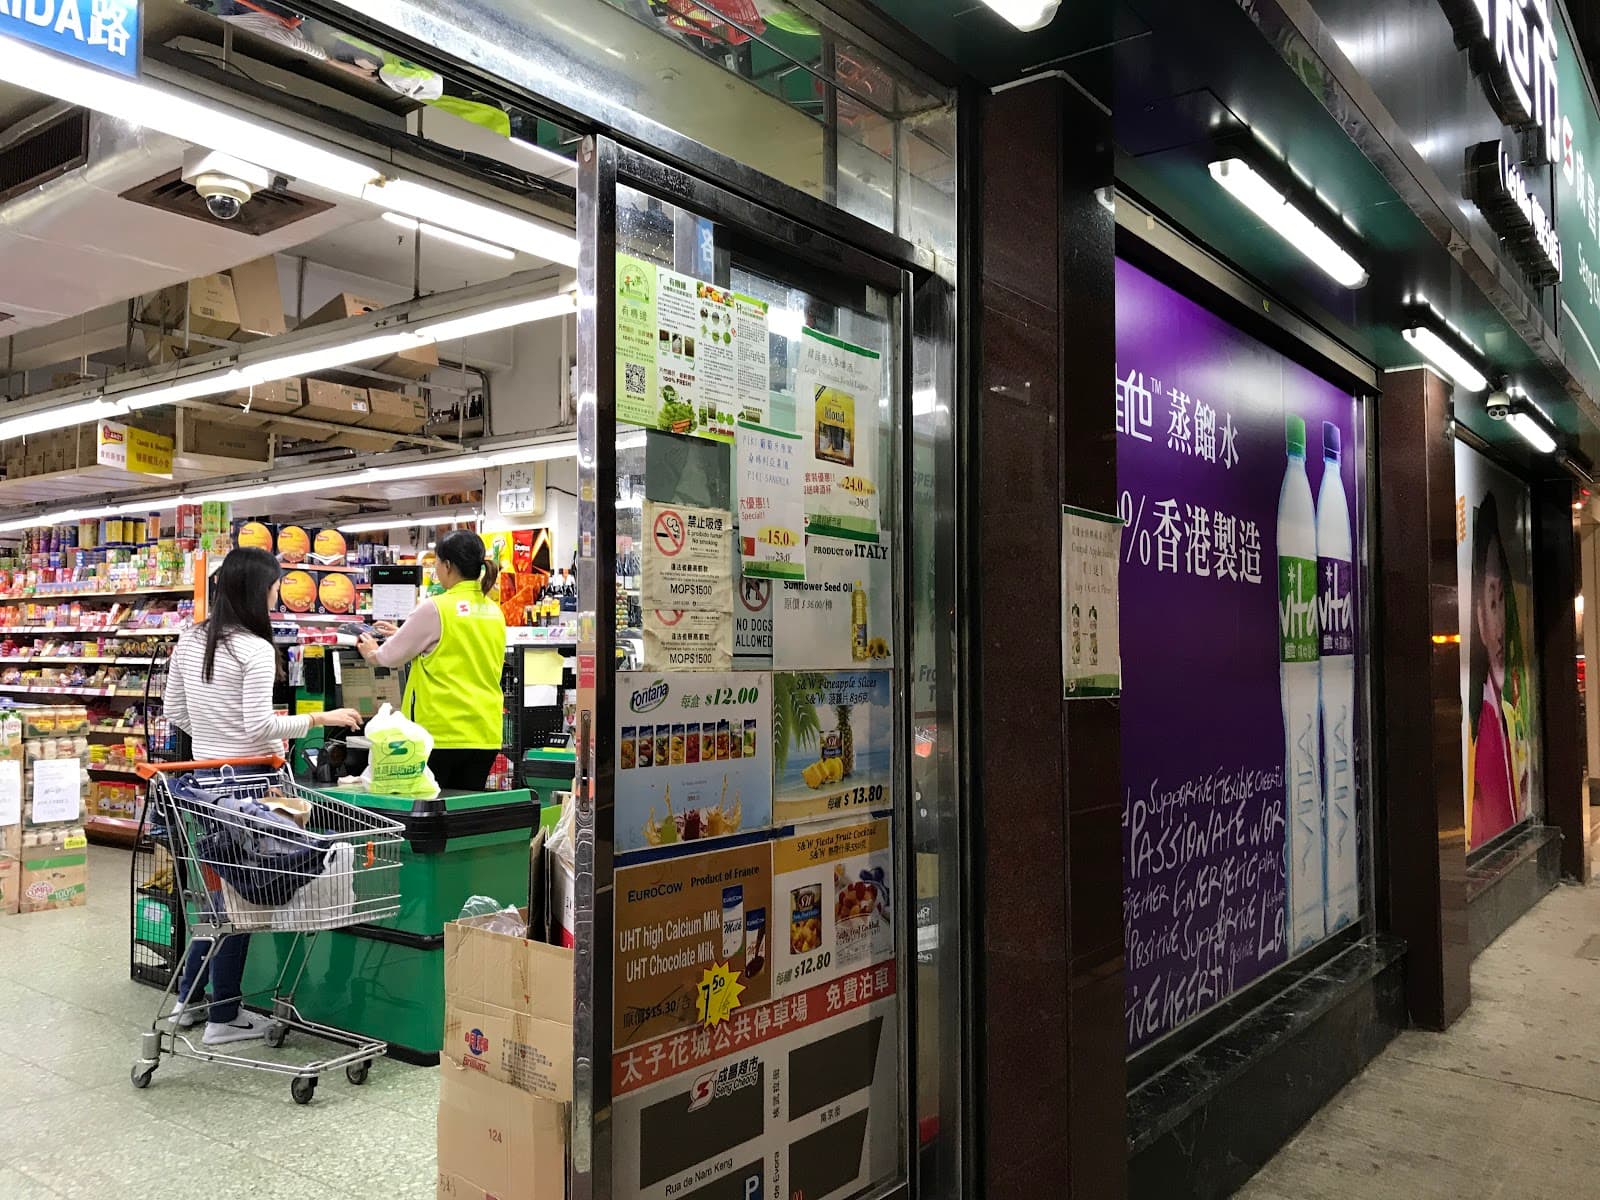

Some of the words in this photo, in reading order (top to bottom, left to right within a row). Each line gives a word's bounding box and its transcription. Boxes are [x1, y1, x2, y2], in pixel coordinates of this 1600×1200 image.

[1167, 387, 1240, 470] 蒸餾水
[687, 515, 723, 531] 禁止吸煙
[768, 530, 790, 545] 15.0
[1116, 489, 1263, 585] %香港製造
[814, 546, 844, 557] PRODUCT
[854, 543, 889, 560] ITALY
[784, 581, 822, 591] Sunflower
[824, 582, 841, 592] Seed
[843, 583, 853, 593] Oil
[736, 618, 748, 632] NO
[751, 618, 773, 632] DOGS
[736, 635, 773, 648] ALLOWED
[631, 682, 669, 707] Fontana
[704, 687, 759, 706] $12.00
[852, 784, 883, 804] 13.80
[690, 872, 722, 887] Product
[724, 869, 733, 880] of
[734, 865, 759, 879] France
[620, 926, 641, 953] UHT
[643, 921, 664, 947] high
[665, 915, 702, 941] Calcium
[703, 909, 721, 931] Milk
[626, 956, 648, 983] UHT
[649, 947, 696, 977] Chocolate
[697, 943, 715, 964] Milk
[794, 951, 831, 979] $12.80
[620, 993, 809, 1088] 太子花城公共停車場
[824, 966, 890, 1012] 免費泊車
[718, 1056, 759, 1083] 成昌超市
[488, 1128, 502, 1143] 124
[665, 1181, 682, 1197] Rua
[695, 1167, 713, 1183] Nam
[745, 1175, 759, 1200] P
